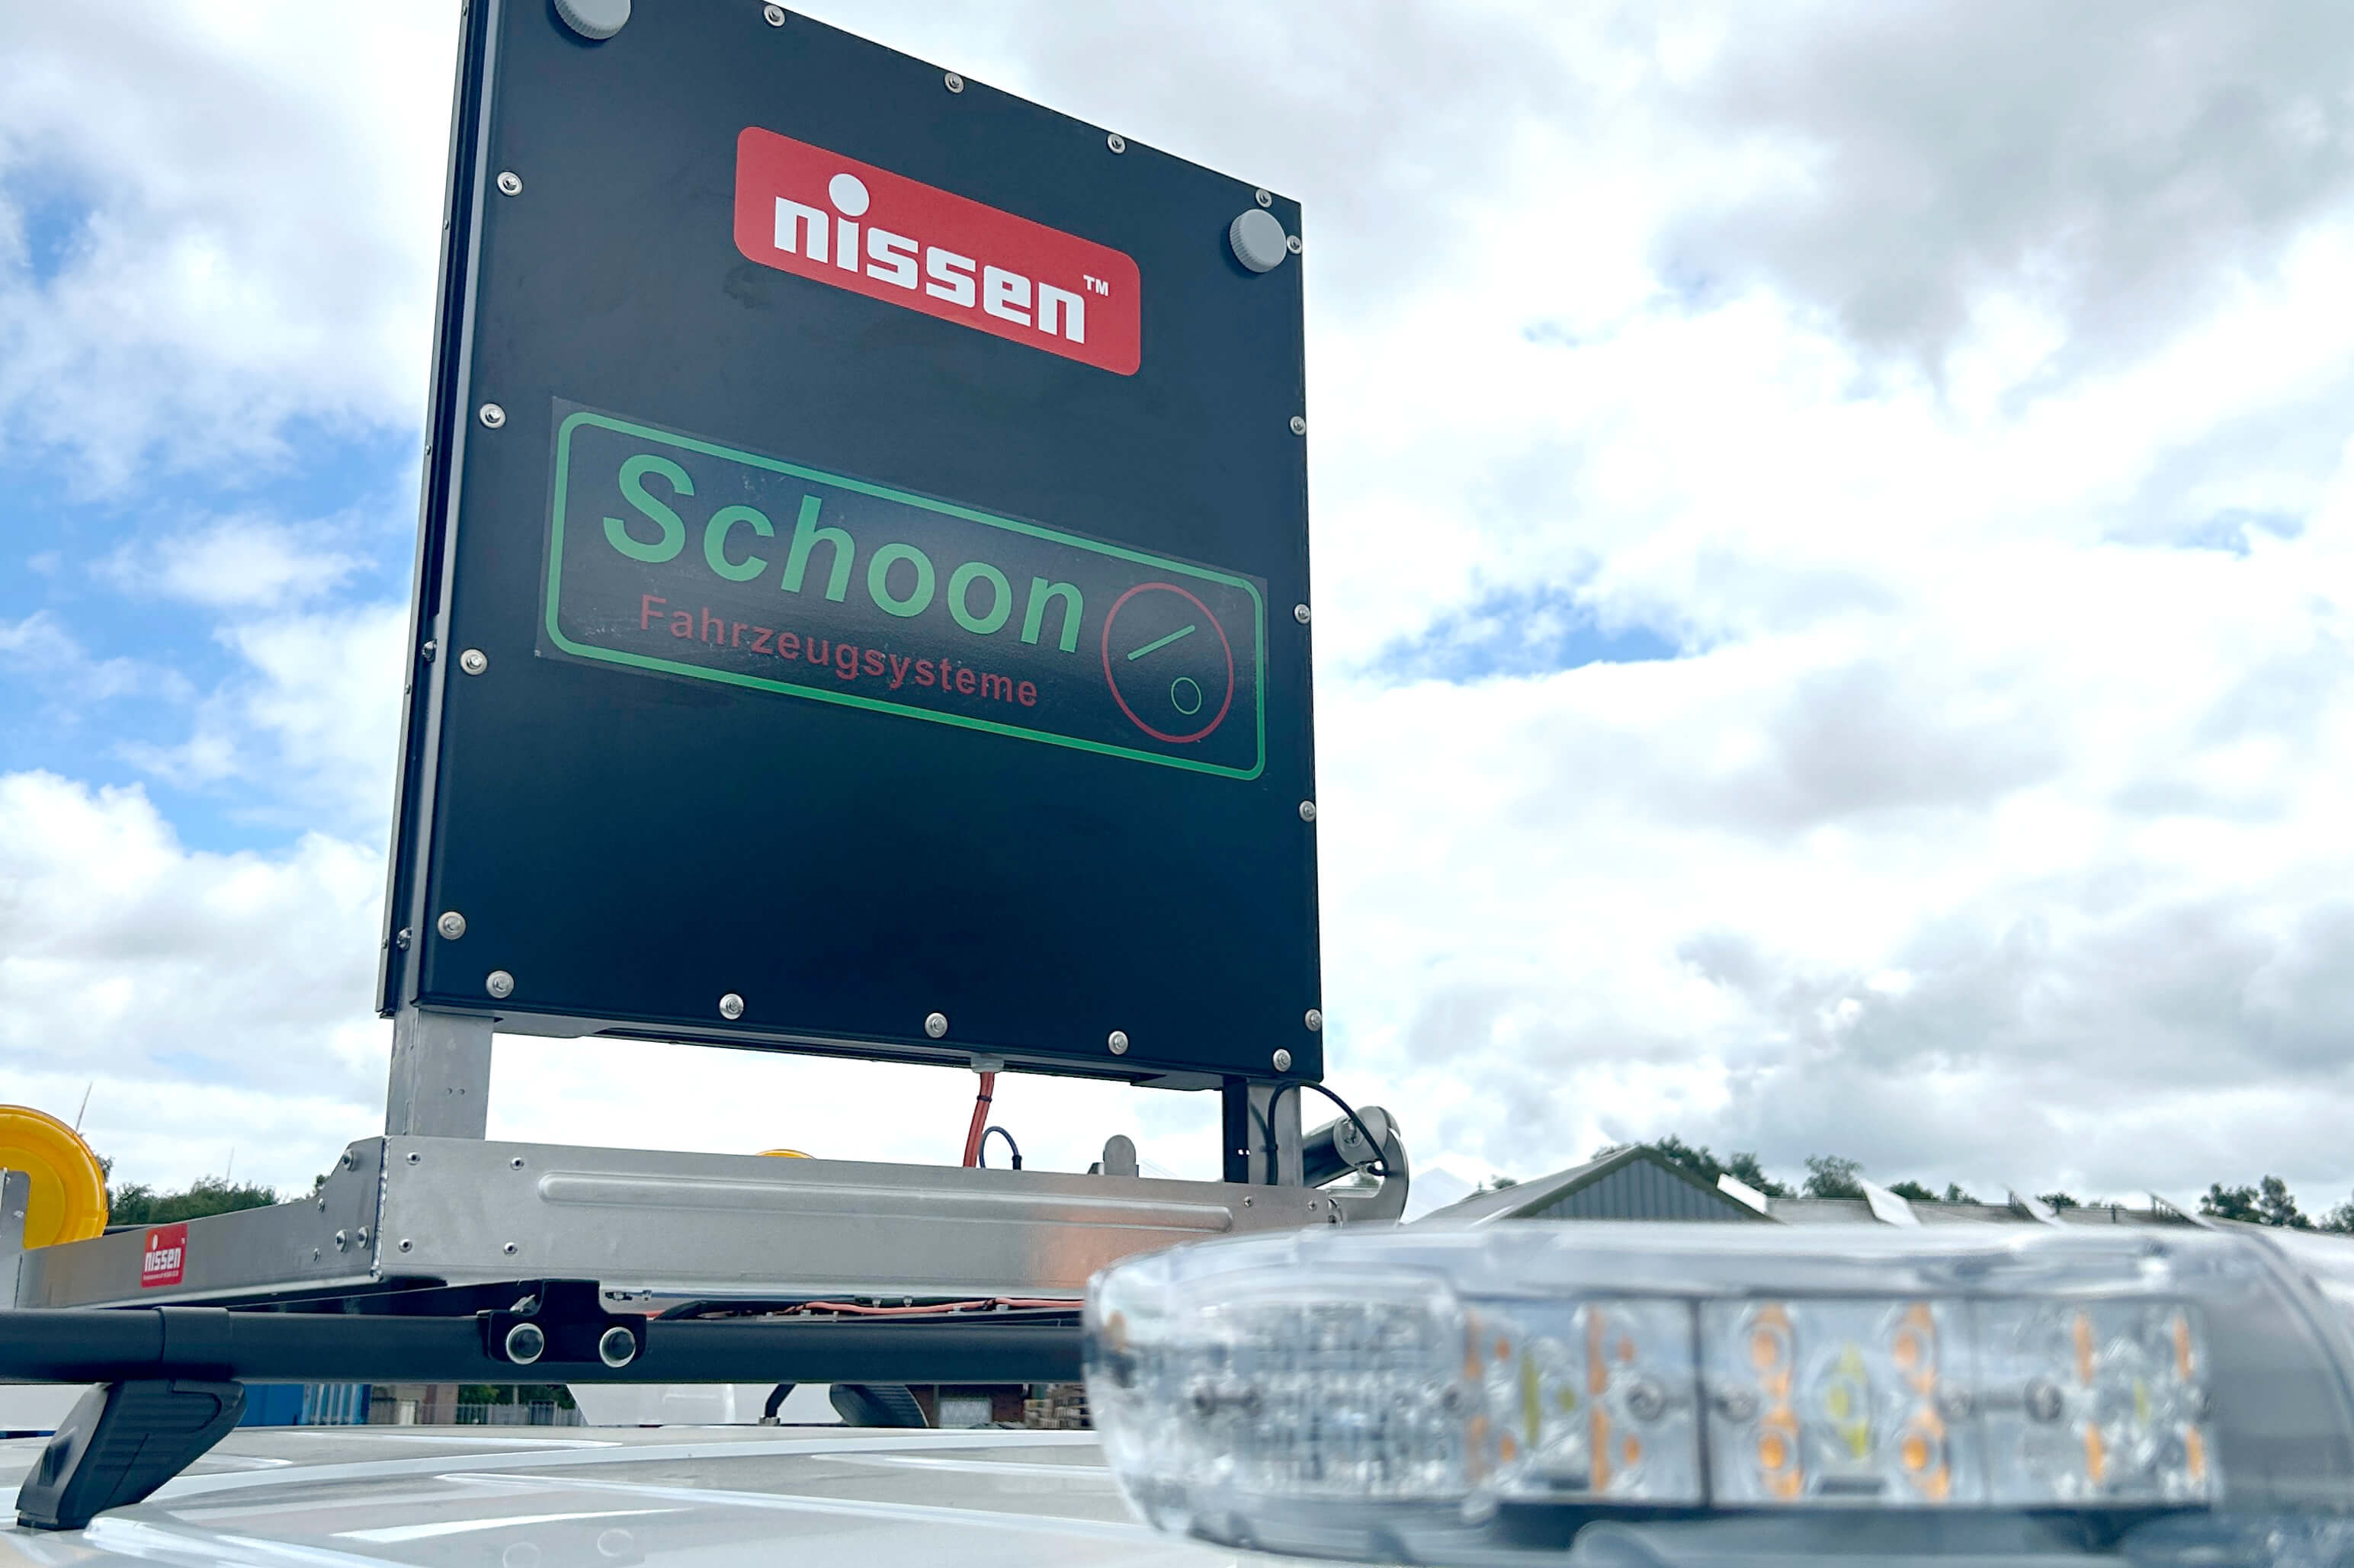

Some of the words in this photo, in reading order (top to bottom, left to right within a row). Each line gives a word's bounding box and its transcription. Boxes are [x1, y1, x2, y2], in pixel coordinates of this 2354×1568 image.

[775, 173, 1085, 345] nissen
[602, 454, 1086, 653] Schoon
[639, 594, 1038, 707] Fahrzeugsysteme
[144, 1234, 182, 1272] nissen
